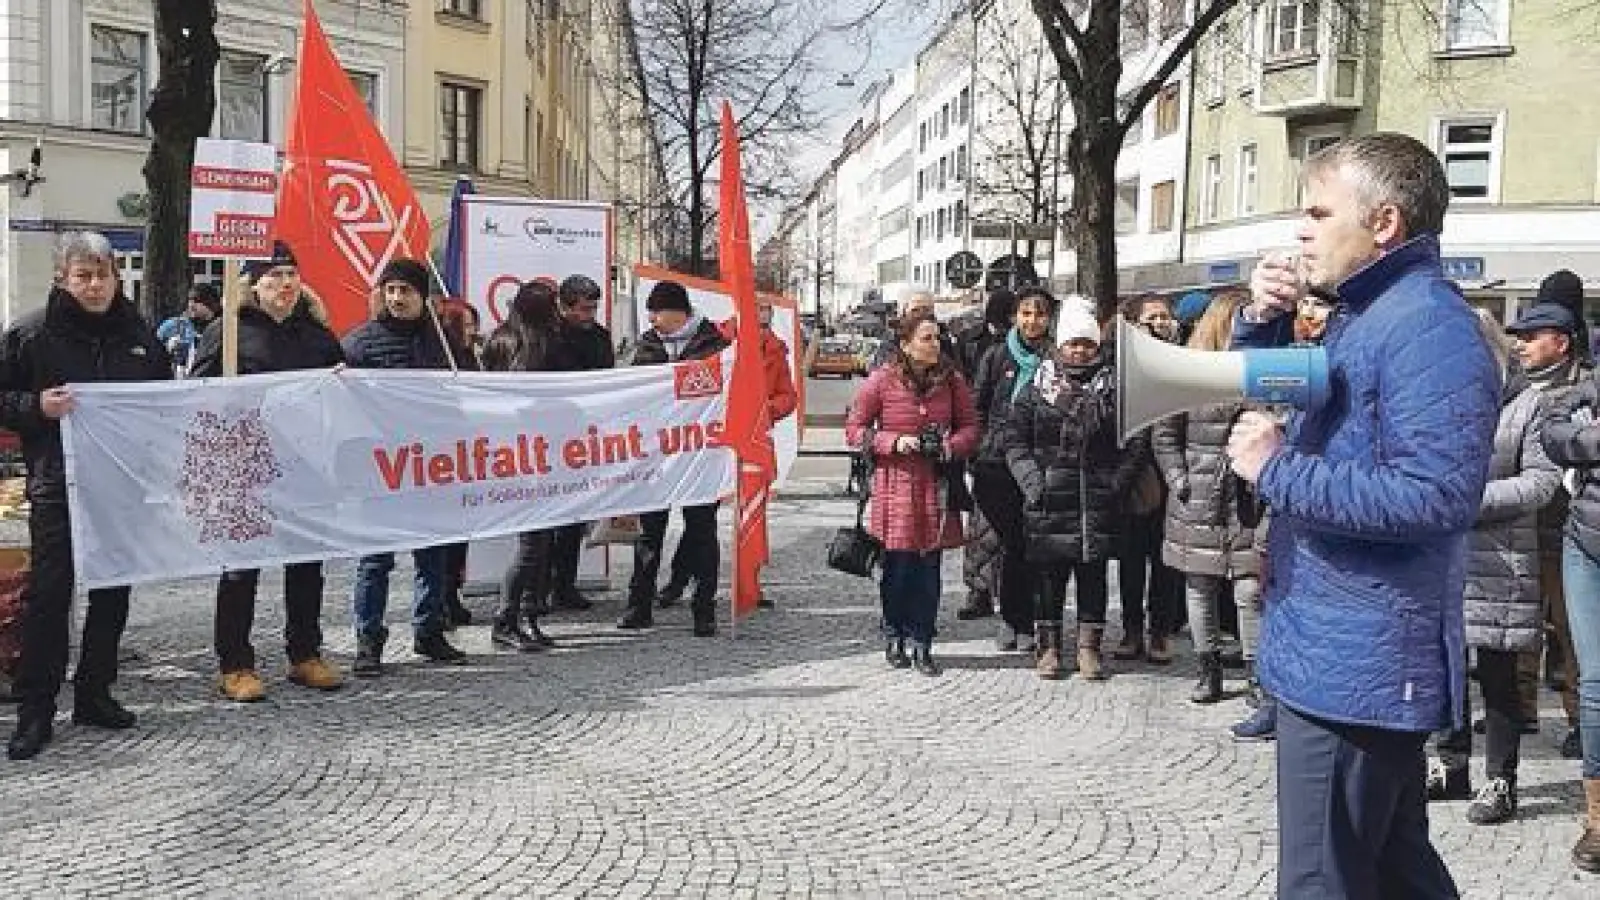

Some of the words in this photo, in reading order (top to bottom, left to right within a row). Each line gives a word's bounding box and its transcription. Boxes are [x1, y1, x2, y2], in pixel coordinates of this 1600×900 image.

[219, 219, 267, 235] GEGEN
[373, 434, 552, 492] Vielfalt
[562, 424, 649, 469] eint
[656, 418, 725, 455] uns
[562, 477, 589, 494] und
